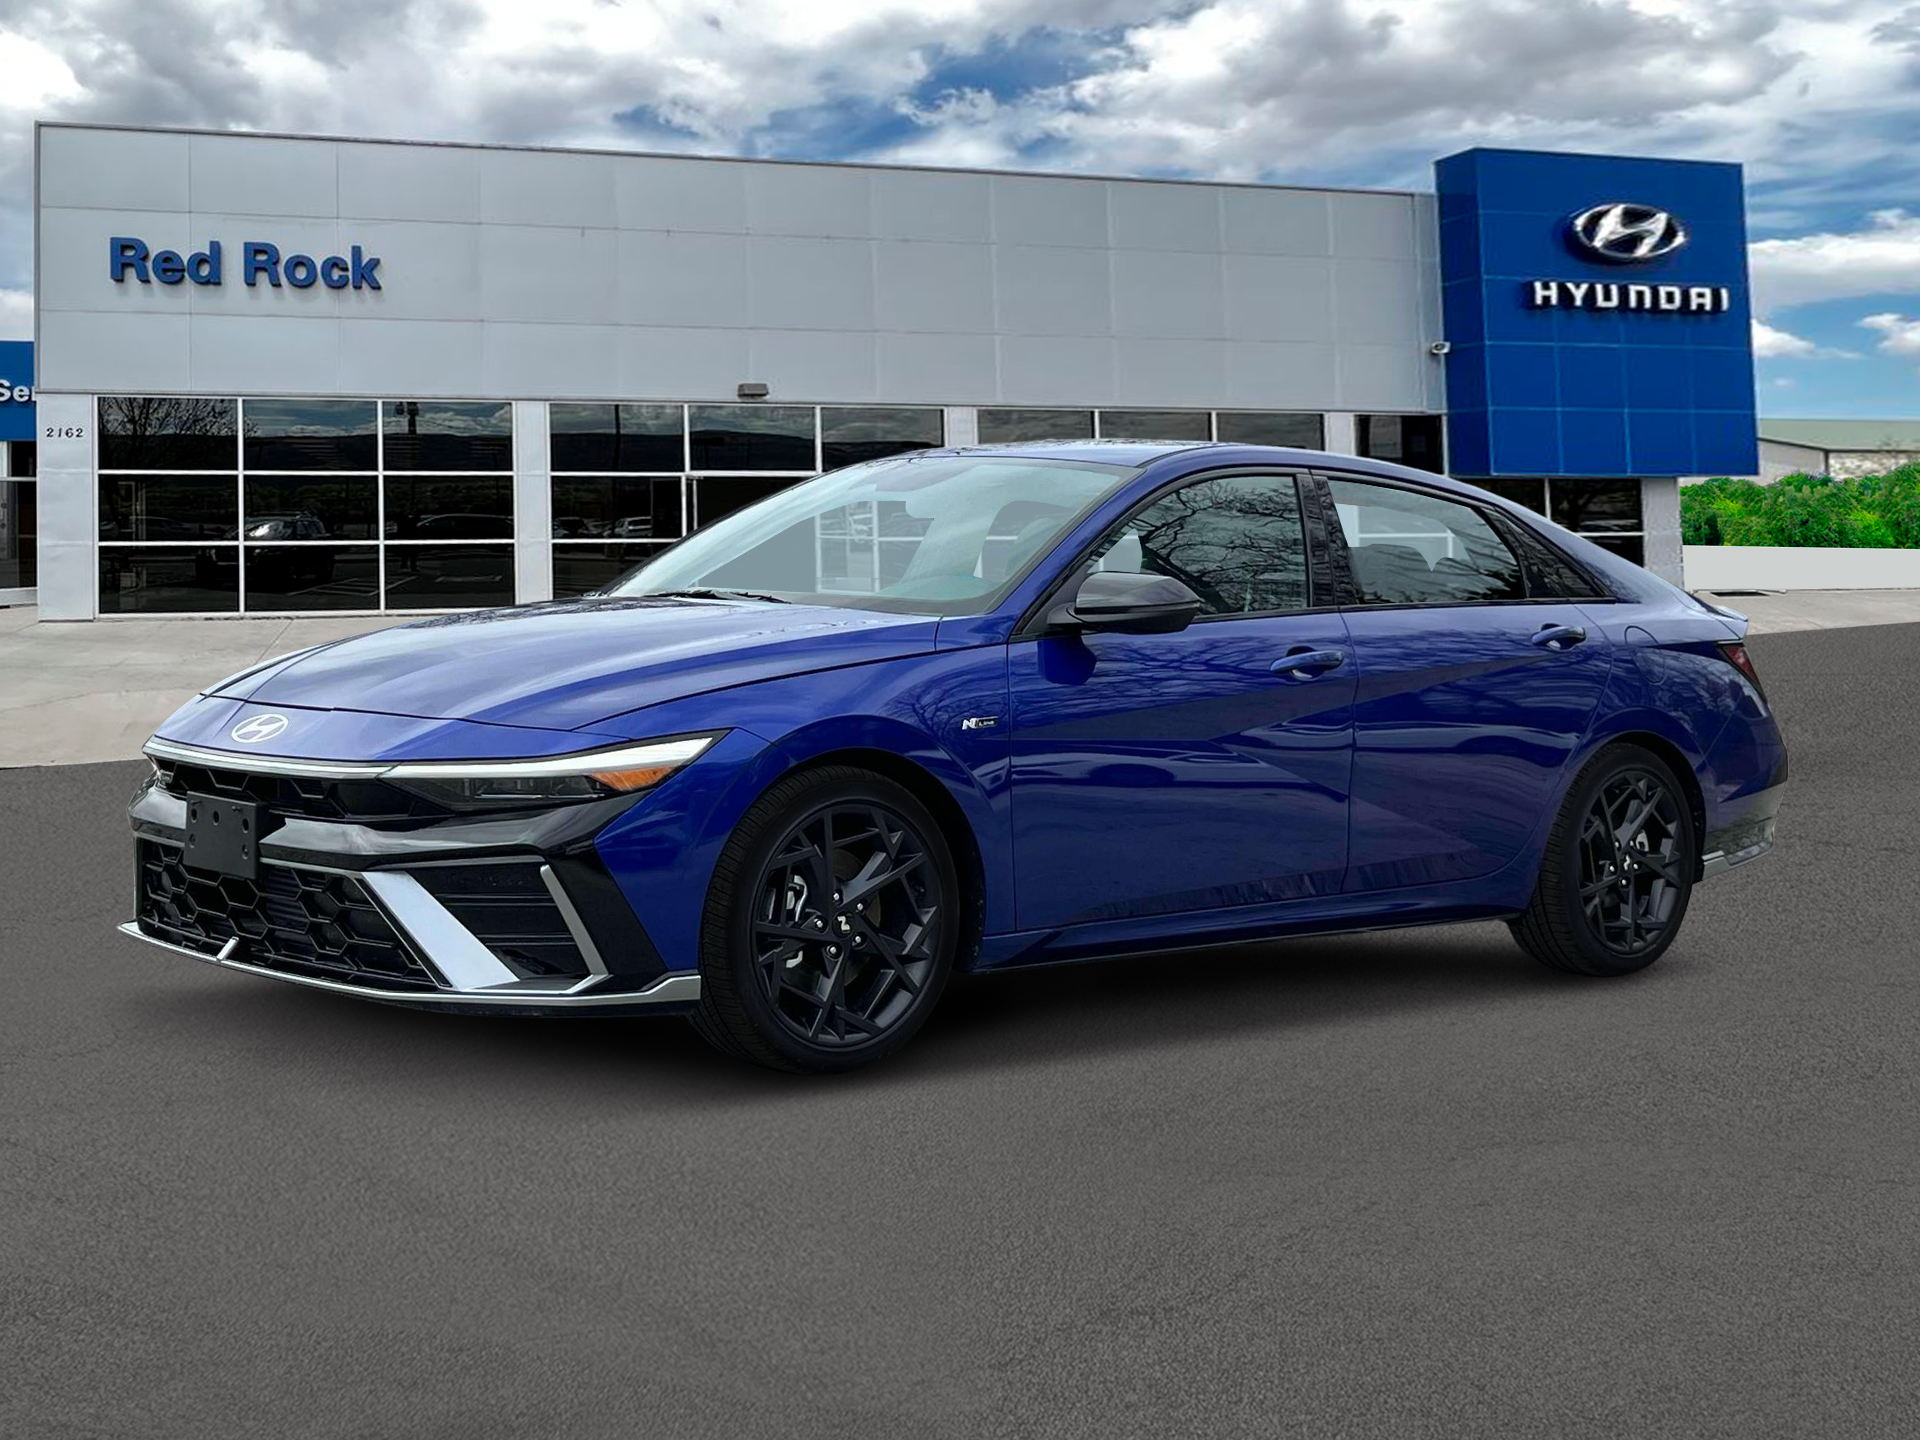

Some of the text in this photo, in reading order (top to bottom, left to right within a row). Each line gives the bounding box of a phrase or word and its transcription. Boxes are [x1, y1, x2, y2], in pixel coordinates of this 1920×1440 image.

[109, 236, 382, 291] Red Rock
[1533, 281, 1729, 311] HYUNDAI
[46, 427, 84, 438] 2162
